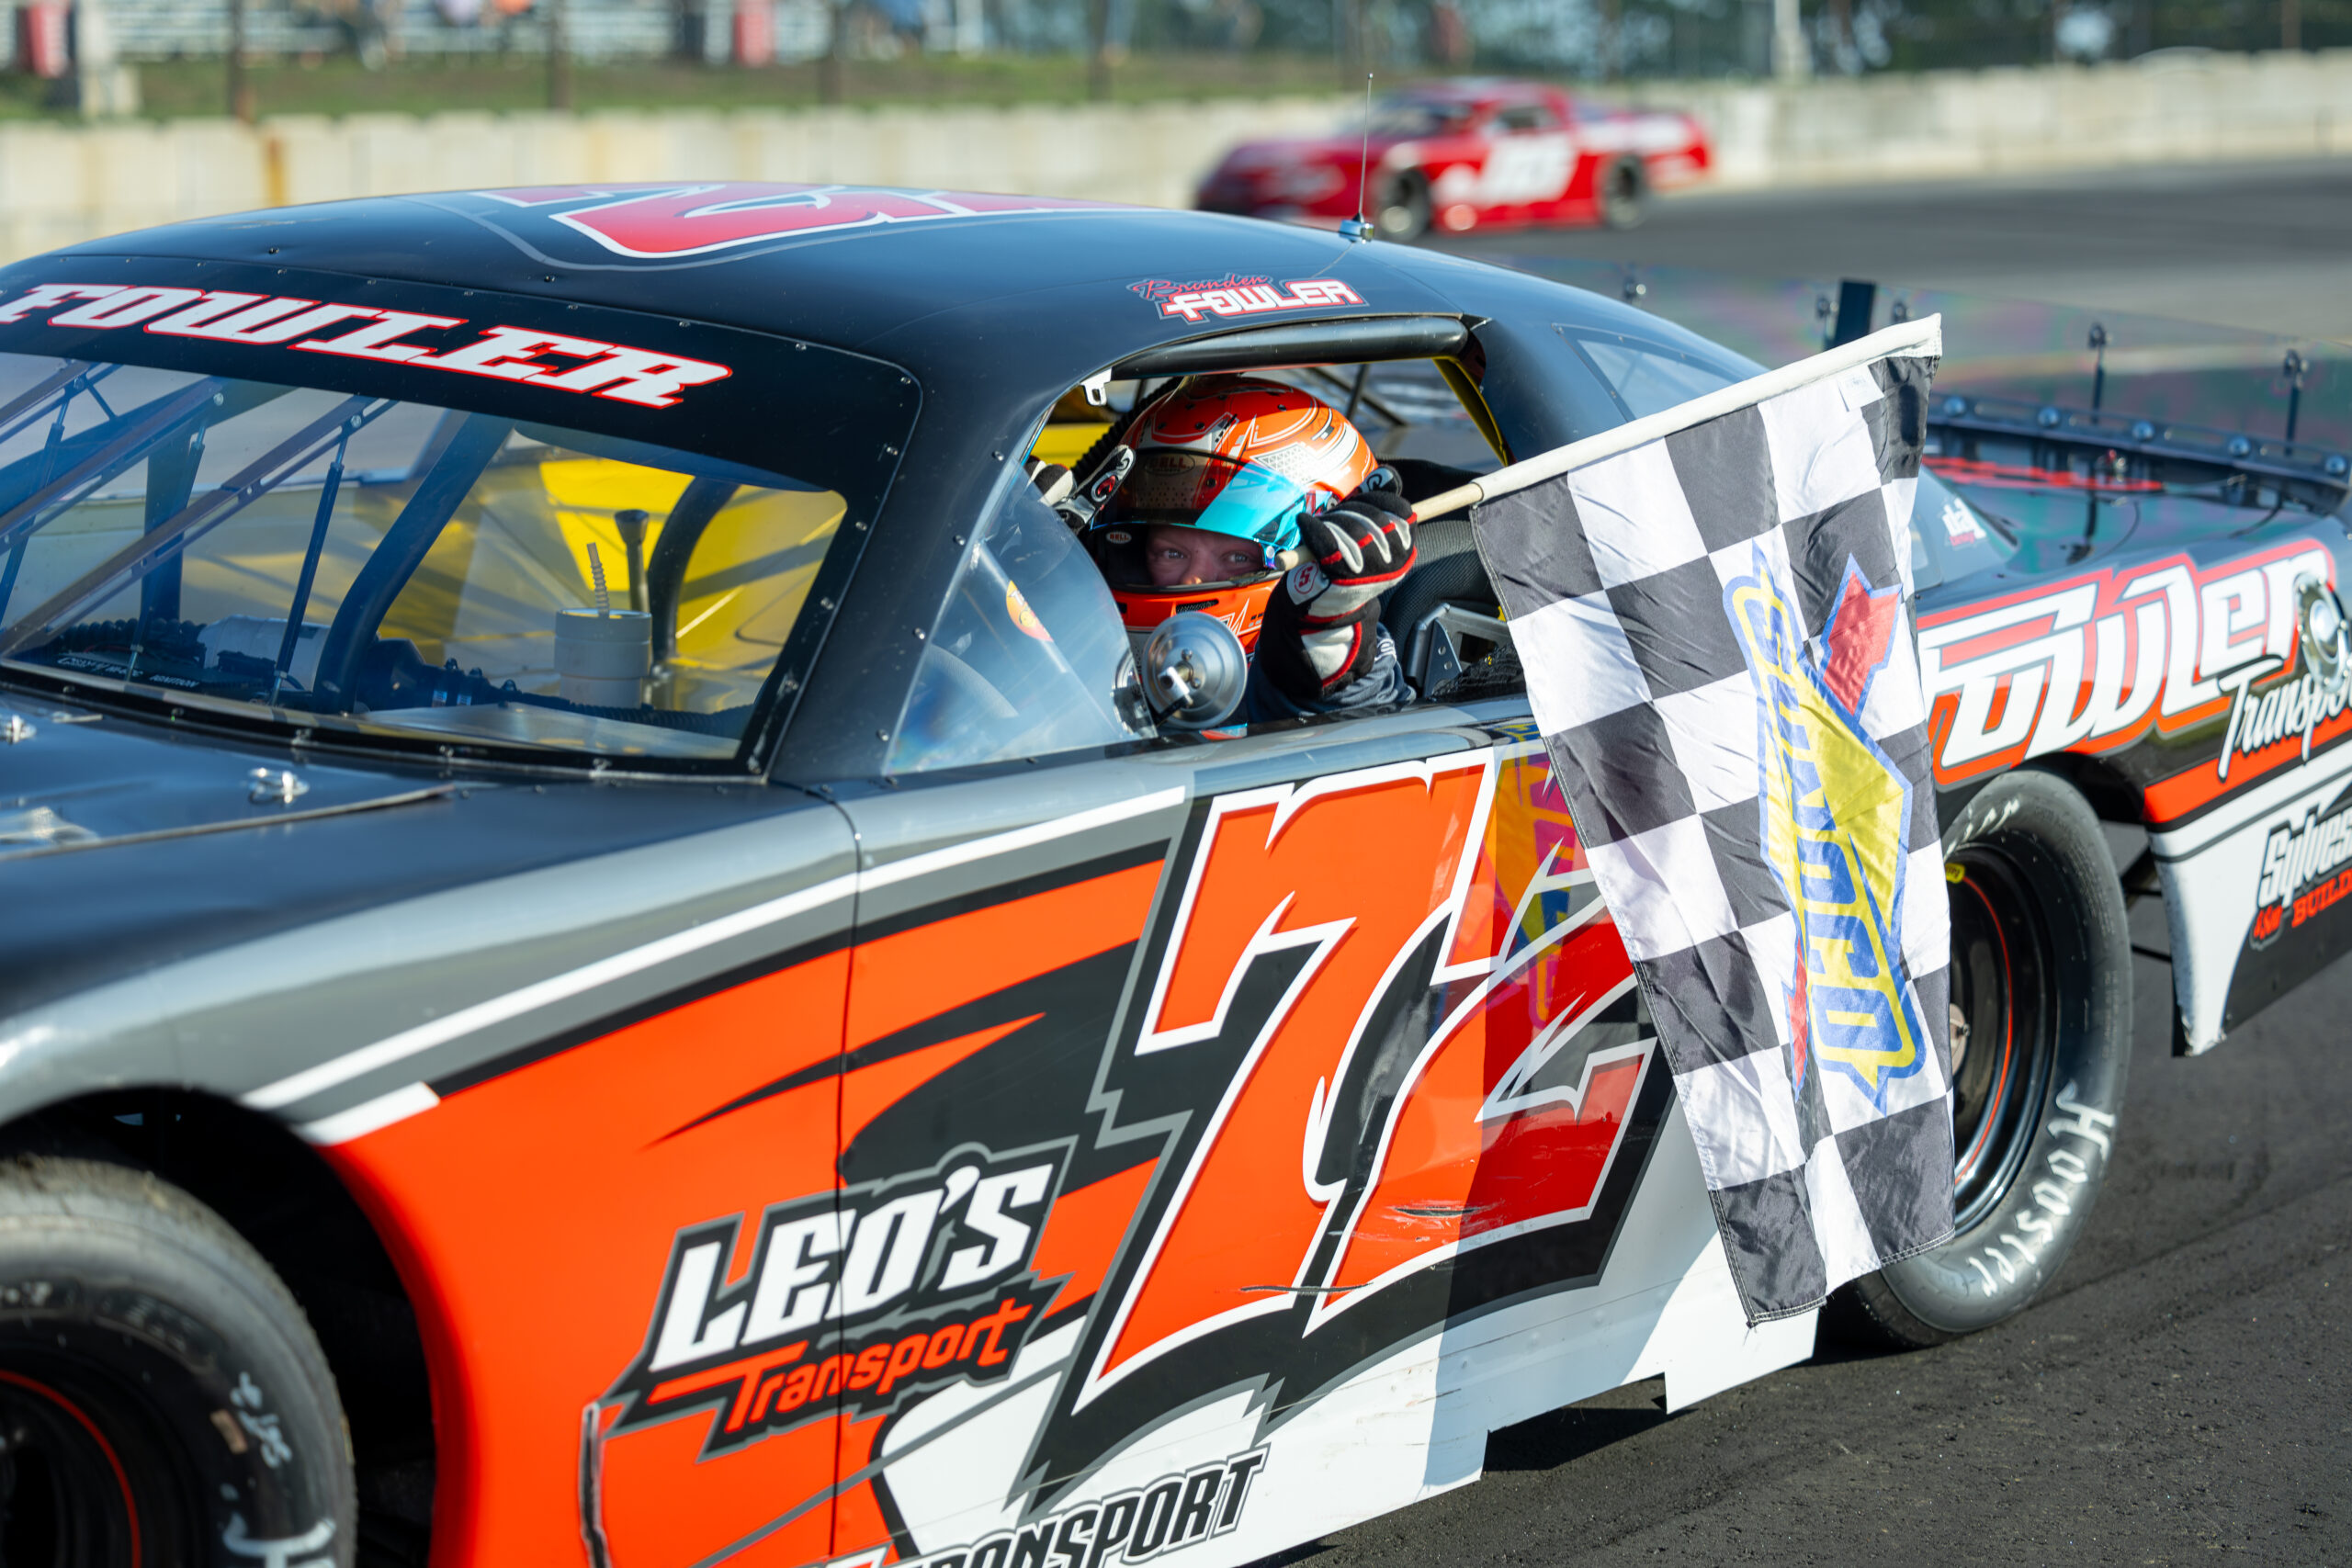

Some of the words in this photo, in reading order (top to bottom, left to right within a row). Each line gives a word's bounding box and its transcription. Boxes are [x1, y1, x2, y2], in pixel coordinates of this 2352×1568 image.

[0, 283, 733, 410] FOWLER
[1132, 274, 1269, 299] Branden
[1160, 279, 1364, 322] FOWLER
[1109, 533, 1130, 542] BELL
[2218, 658, 2352, 779] Transpo
[1750, 588, 1905, 1054] SUNOCO
[649, 1164, 1054, 1372] LEO'S
[647, 1297, 1034, 1433] Transport
